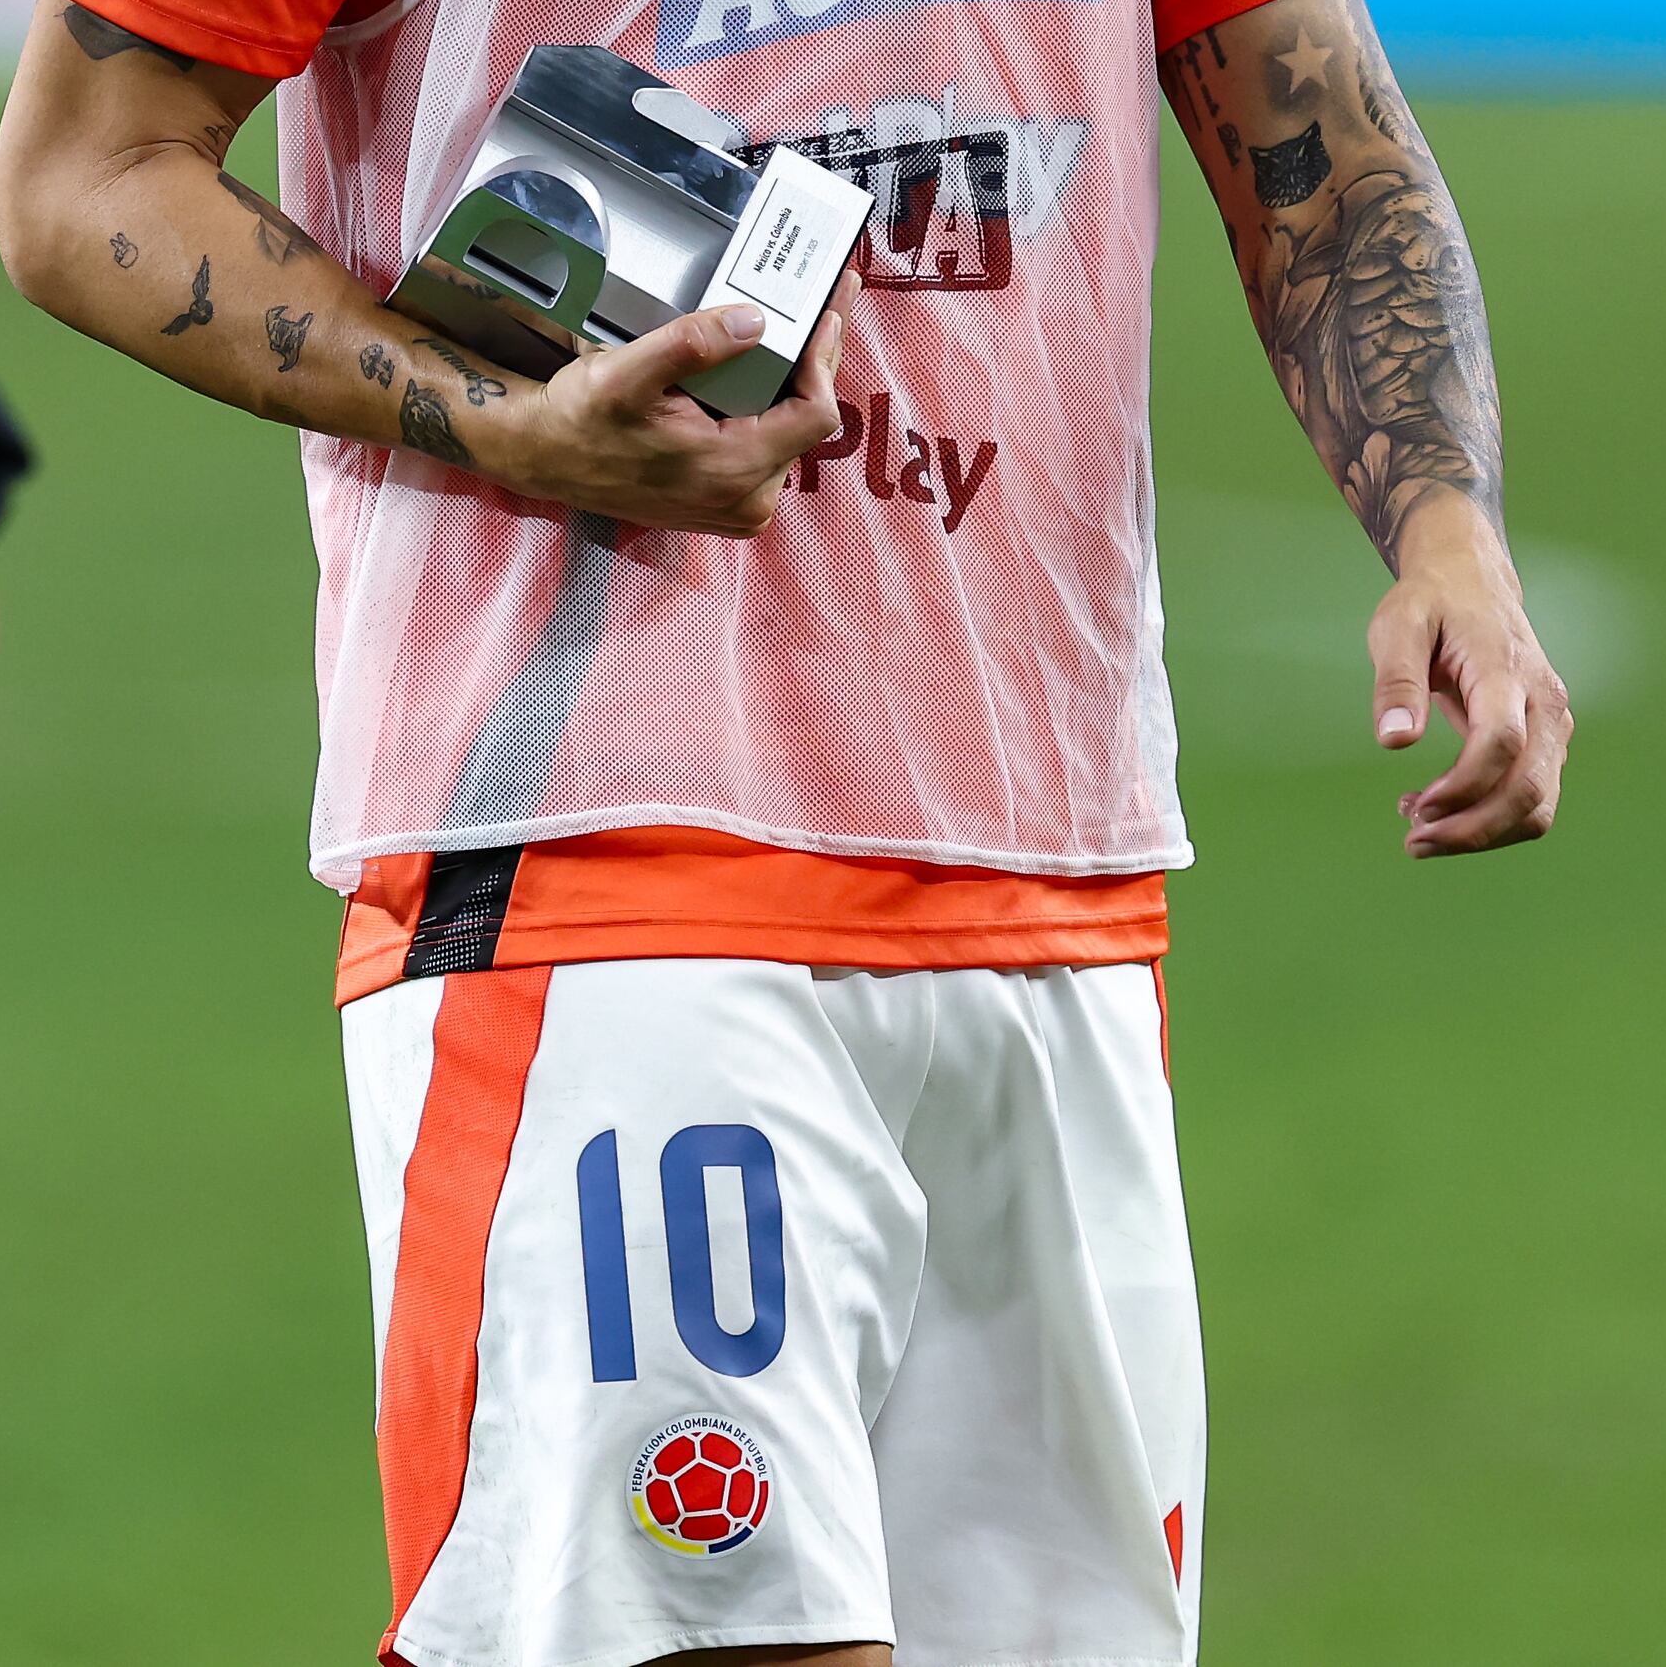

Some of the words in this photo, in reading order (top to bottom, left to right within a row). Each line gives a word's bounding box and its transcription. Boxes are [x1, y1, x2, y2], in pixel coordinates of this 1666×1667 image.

[770, 207, 793, 238] Colombia
[772, 250, 788, 272] AT&T
[781, 225, 802, 254] Stadium
[576, 1123, 787, 1383] 10
[665, 1417, 733, 1437] COLOMBIANA
[733, 1428, 747, 1442] DE
